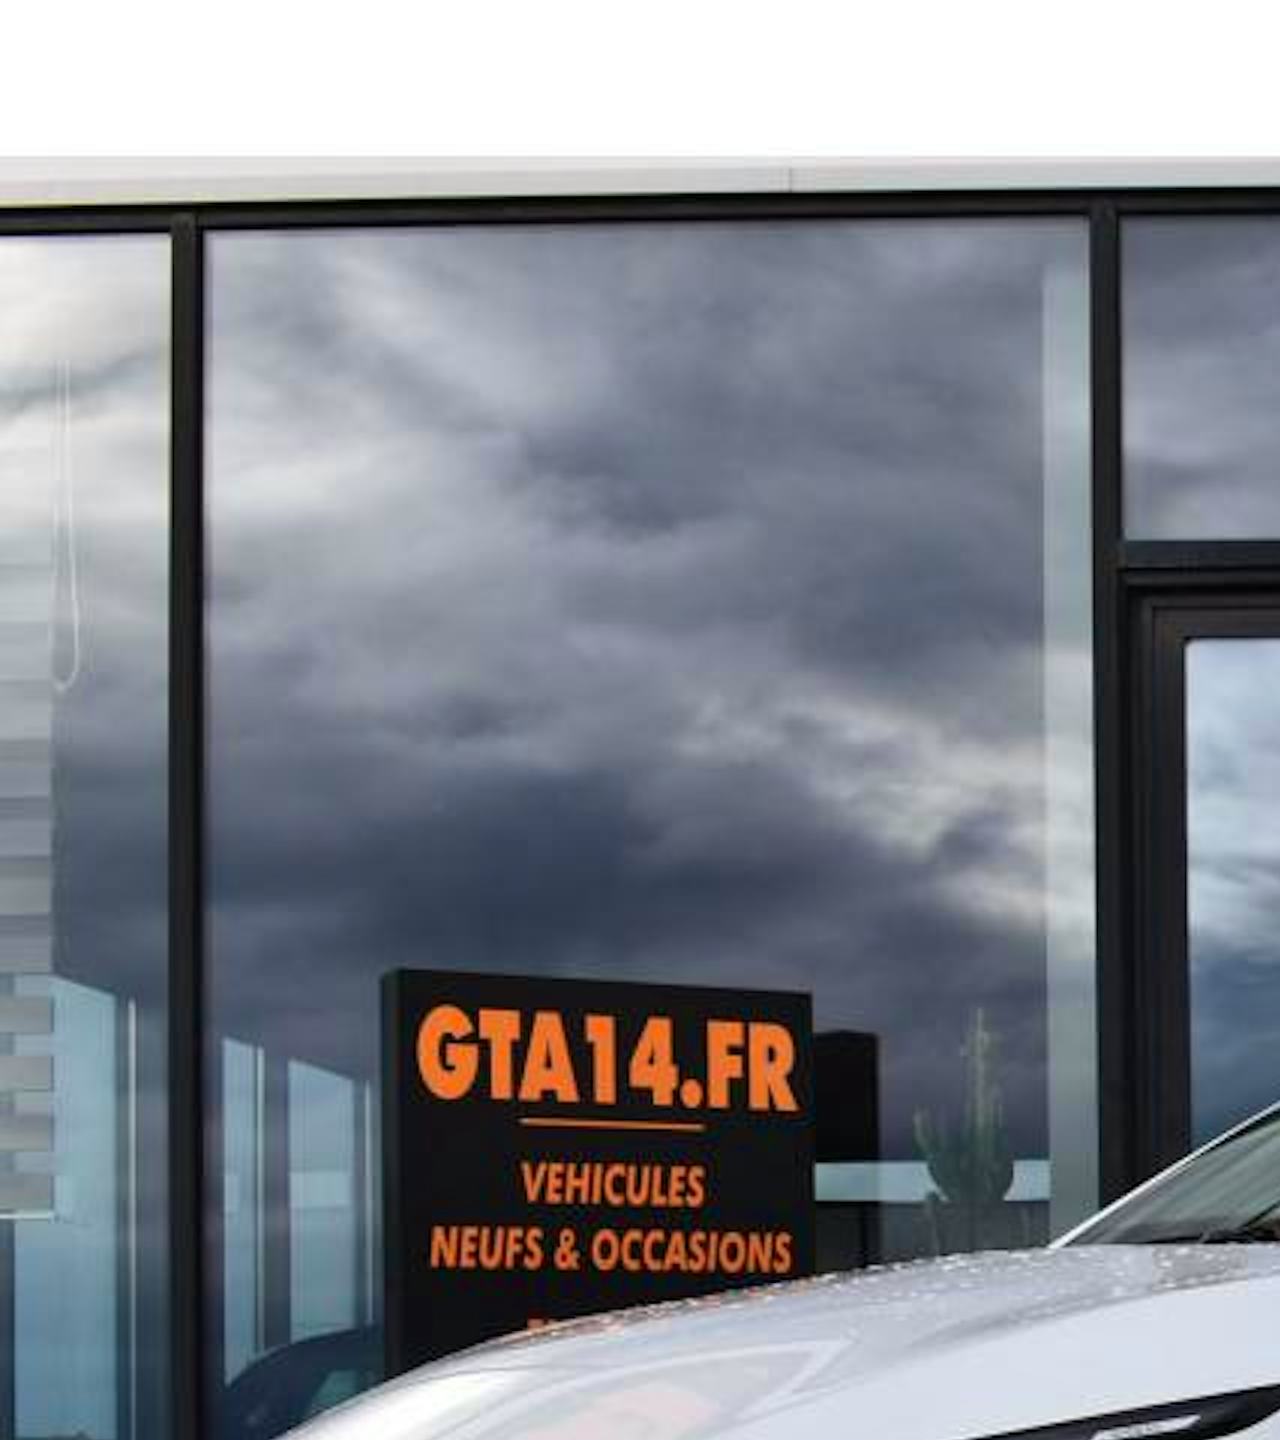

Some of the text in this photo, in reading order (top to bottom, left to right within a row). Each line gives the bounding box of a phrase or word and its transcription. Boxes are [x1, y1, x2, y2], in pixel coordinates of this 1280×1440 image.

[416, 1003, 799, 1112] GTA14.FR
[521, 1161, 706, 1208] VEHICULES
[430, 1225, 794, 1275] NEUFS & OCCASIONS
